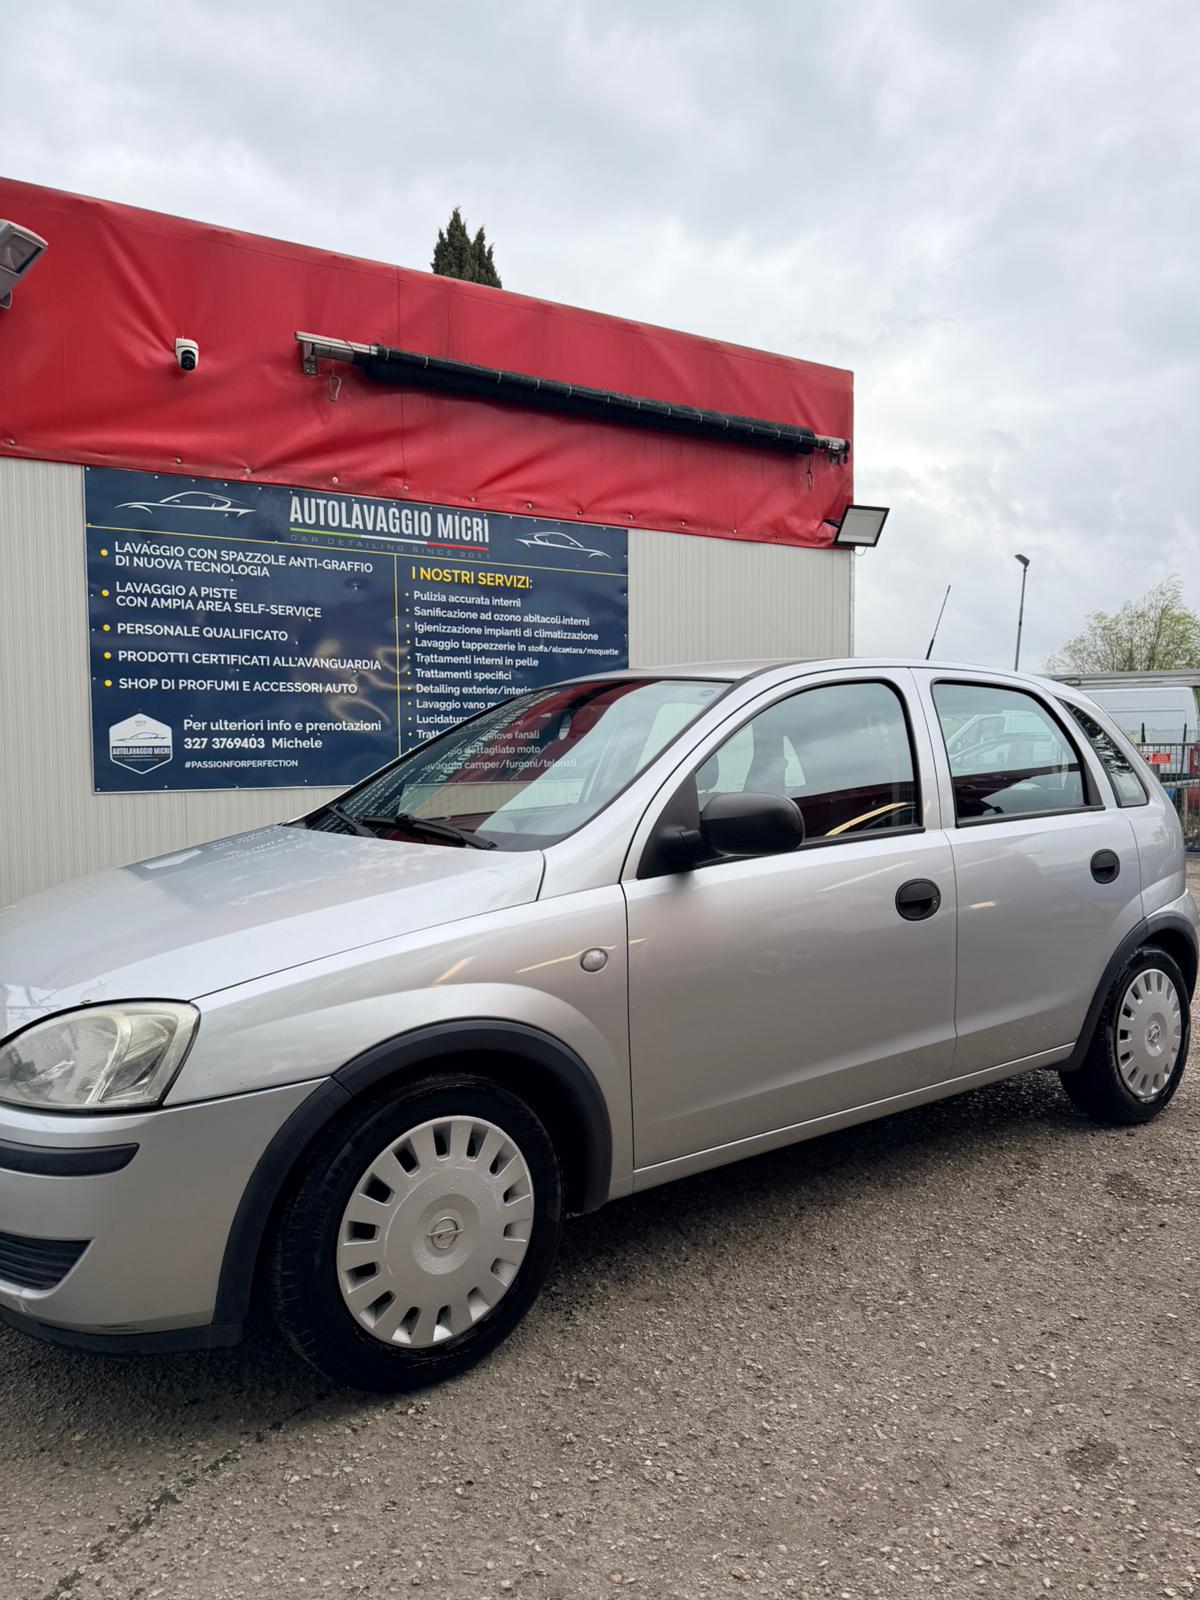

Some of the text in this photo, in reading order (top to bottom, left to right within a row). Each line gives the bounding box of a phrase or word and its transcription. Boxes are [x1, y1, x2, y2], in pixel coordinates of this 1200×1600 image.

[290, 496, 490, 543] AUTOLAVAGGIO MICRI
[290, 534, 318, 544] CAR
[328, 538, 405, 552] DETAILING
[412, 546, 452, 557] SINCE
[115, 541, 373, 573] LAVAGGIO CON SPAZZOLE ANTI-GRAFFIO
[115, 555, 271, 577] DI NUOVA TECNOLOGIA
[411, 566, 533, 589] I NOSTRI SERVIZI:
[116, 581, 238, 600] LAVAGGIO A PISTE
[413, 591, 521, 607] Pulizia accurata interni
[116, 595, 322, 618] CON AMPIA AREA SELF-SERVICE
[414, 607, 590, 627] Sanificazione ad ozono abitacoli interni
[117, 623, 288, 642] PERSONALE QUALIFICATO
[414, 622, 599, 641] Igienizzazione impianti di climatizzazione
[415, 638, 619, 656] Lavaggio tappezzerie in stoffa/alcantara/moquette
[118, 650, 381, 671] PRODOTTI CERTIFICATI ALL'AVANGUARDIA
[415, 654, 539, 668] Trattamenti interni in pelle
[415, 669, 512, 682] Trattamenti specifici
[119, 678, 358, 694] SHOP DI PROFUMI E ACCESSORI AUTO
[416, 684, 533, 696] Detailing exterior/interi
[416, 699, 461, 711] Lavaggio
[463, 701, 485, 709] vano
[183, 719, 381, 733] Per ulteriori info e prenotazioni
[514, 730, 539, 739] fanali
[184, 737, 322, 749] 327 3769403 Michele
[517, 745, 540, 754] moto
[185, 759, 298, 768] #PASSIONFORPERFECTION
[465, 759, 577, 771] camper/furgoni/telonati
